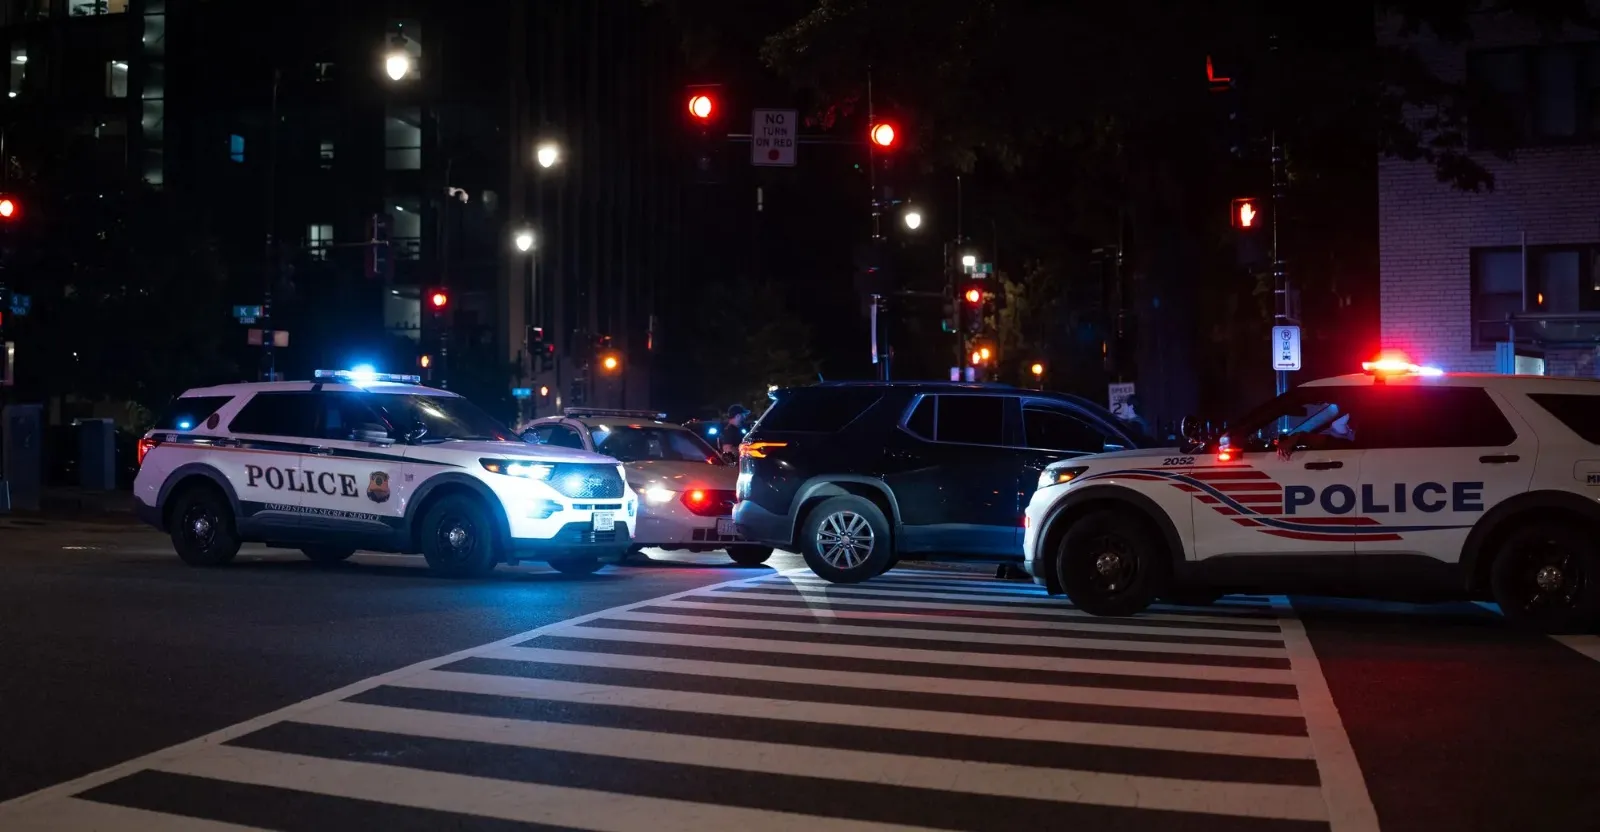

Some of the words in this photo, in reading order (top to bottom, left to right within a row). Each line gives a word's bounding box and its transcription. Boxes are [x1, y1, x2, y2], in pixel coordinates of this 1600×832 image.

[766, 113, 784, 124] NO
[763, 127, 787, 137] TURN
[756, 138, 769, 147] ON
[774, 139, 792, 147] RED
[1163, 457, 1195, 466] 2052
[245, 464, 359, 497] POLICE
[1285, 482, 1484, 514] POLICE
[264, 503, 291, 512] UNITED
[292, 505, 318, 515] STATES
[319, 508, 347, 518] SECRET
[348, 511, 380, 521] SERVICE
